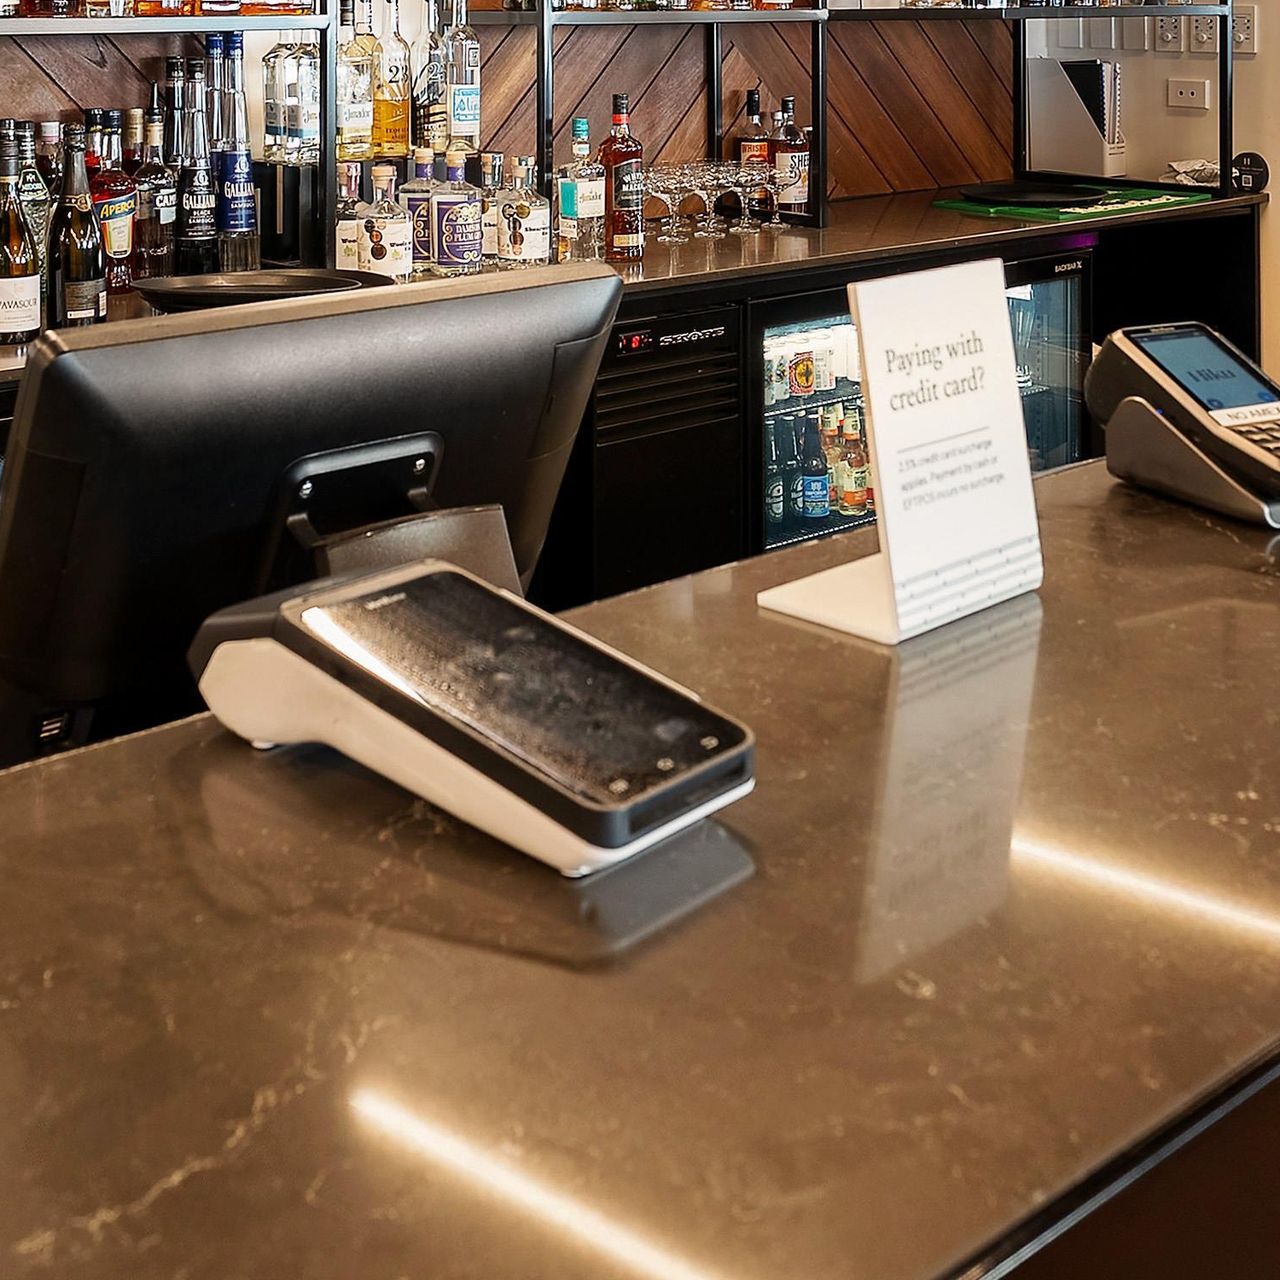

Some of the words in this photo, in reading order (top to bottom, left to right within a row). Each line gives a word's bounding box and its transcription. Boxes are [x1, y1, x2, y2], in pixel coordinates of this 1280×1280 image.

[885, 342, 943, 376] Paying
[946, 330, 984, 358] with
[890, 379, 939, 411] credit
[943, 366, 985, 398] card?
